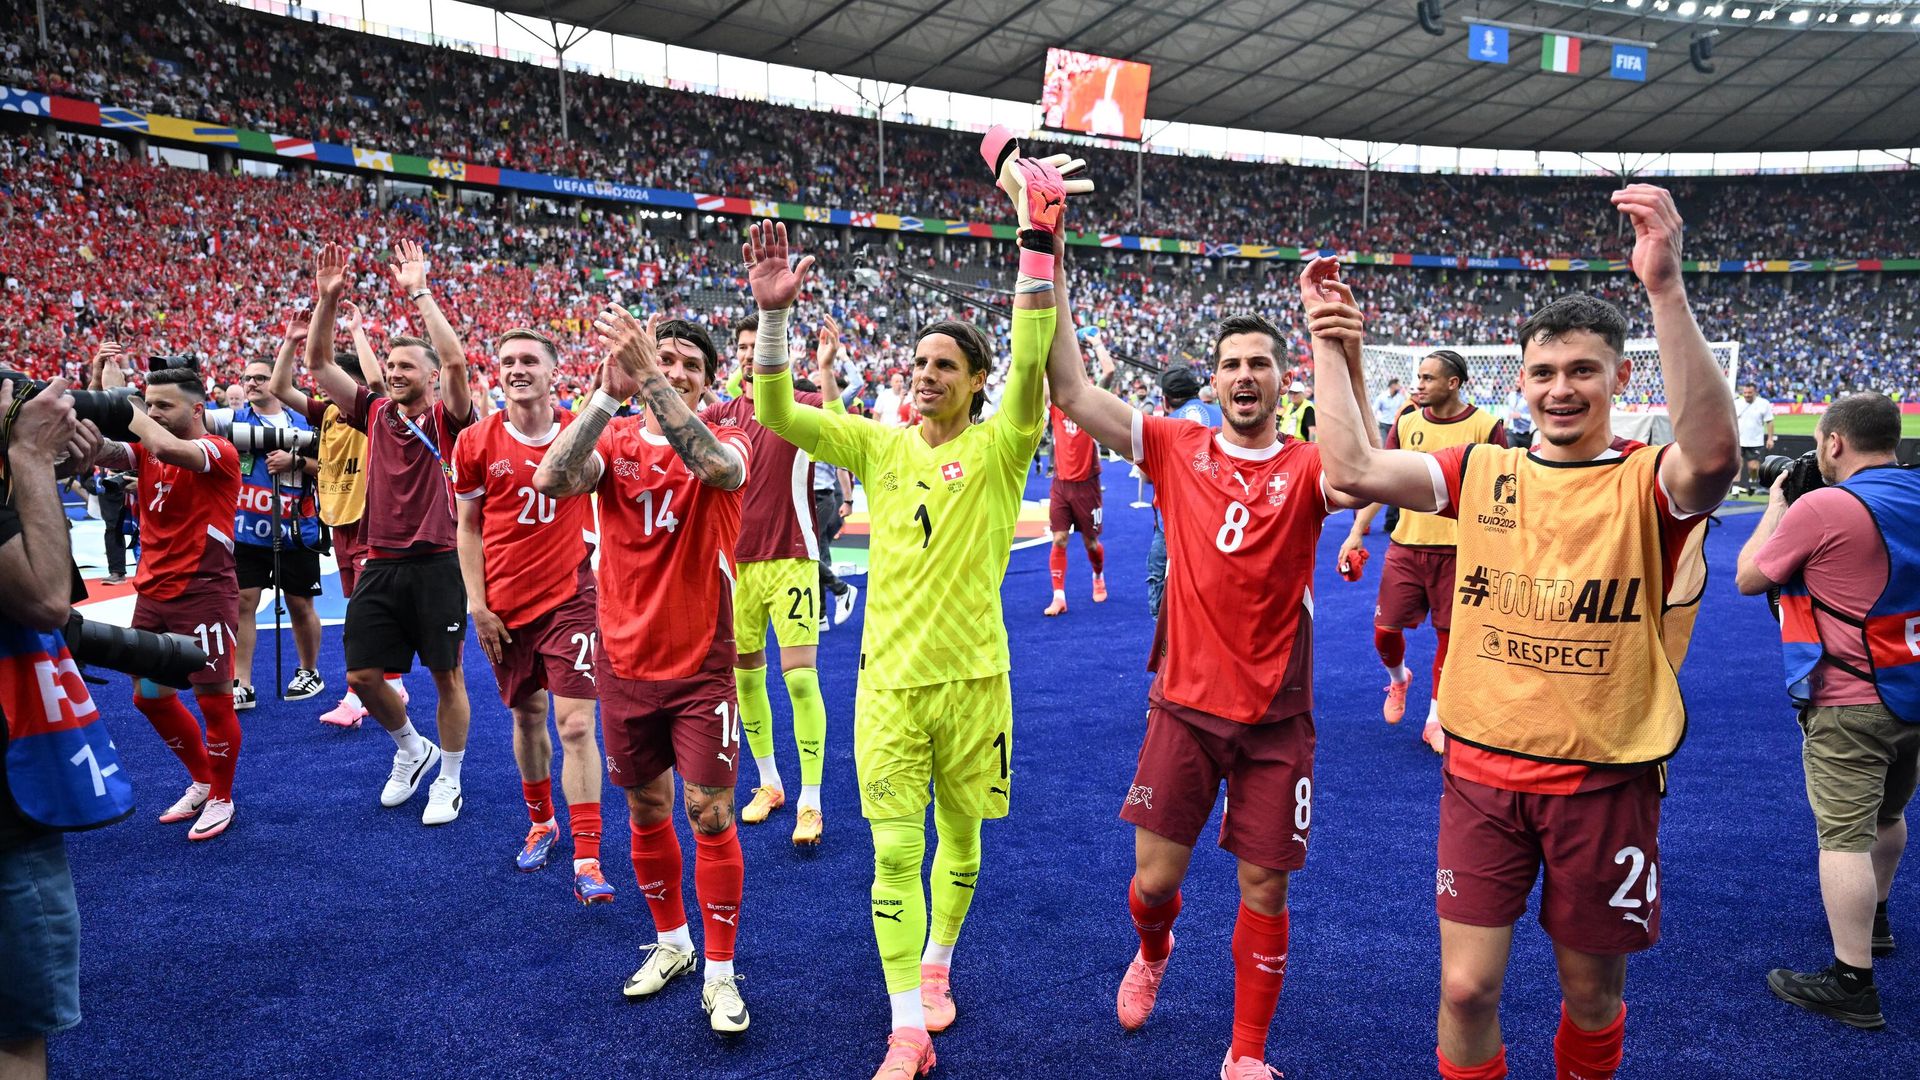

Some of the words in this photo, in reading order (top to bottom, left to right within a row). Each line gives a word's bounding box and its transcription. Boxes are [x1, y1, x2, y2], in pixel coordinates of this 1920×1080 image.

[1616, 53, 1642, 71] FIFA
[636, 489, 679, 536] 14
[914, 503, 932, 549] 1
[1216, 500, 1250, 553] 8
[787, 587, 813, 620] 21
[1458, 565, 1642, 624] #FOOTBALL
[193, 622, 225, 656] 11
[1507, 639, 1610, 668] RESPECT
[992, 732, 1007, 780] 1
[1294, 776, 1311, 830] 8
